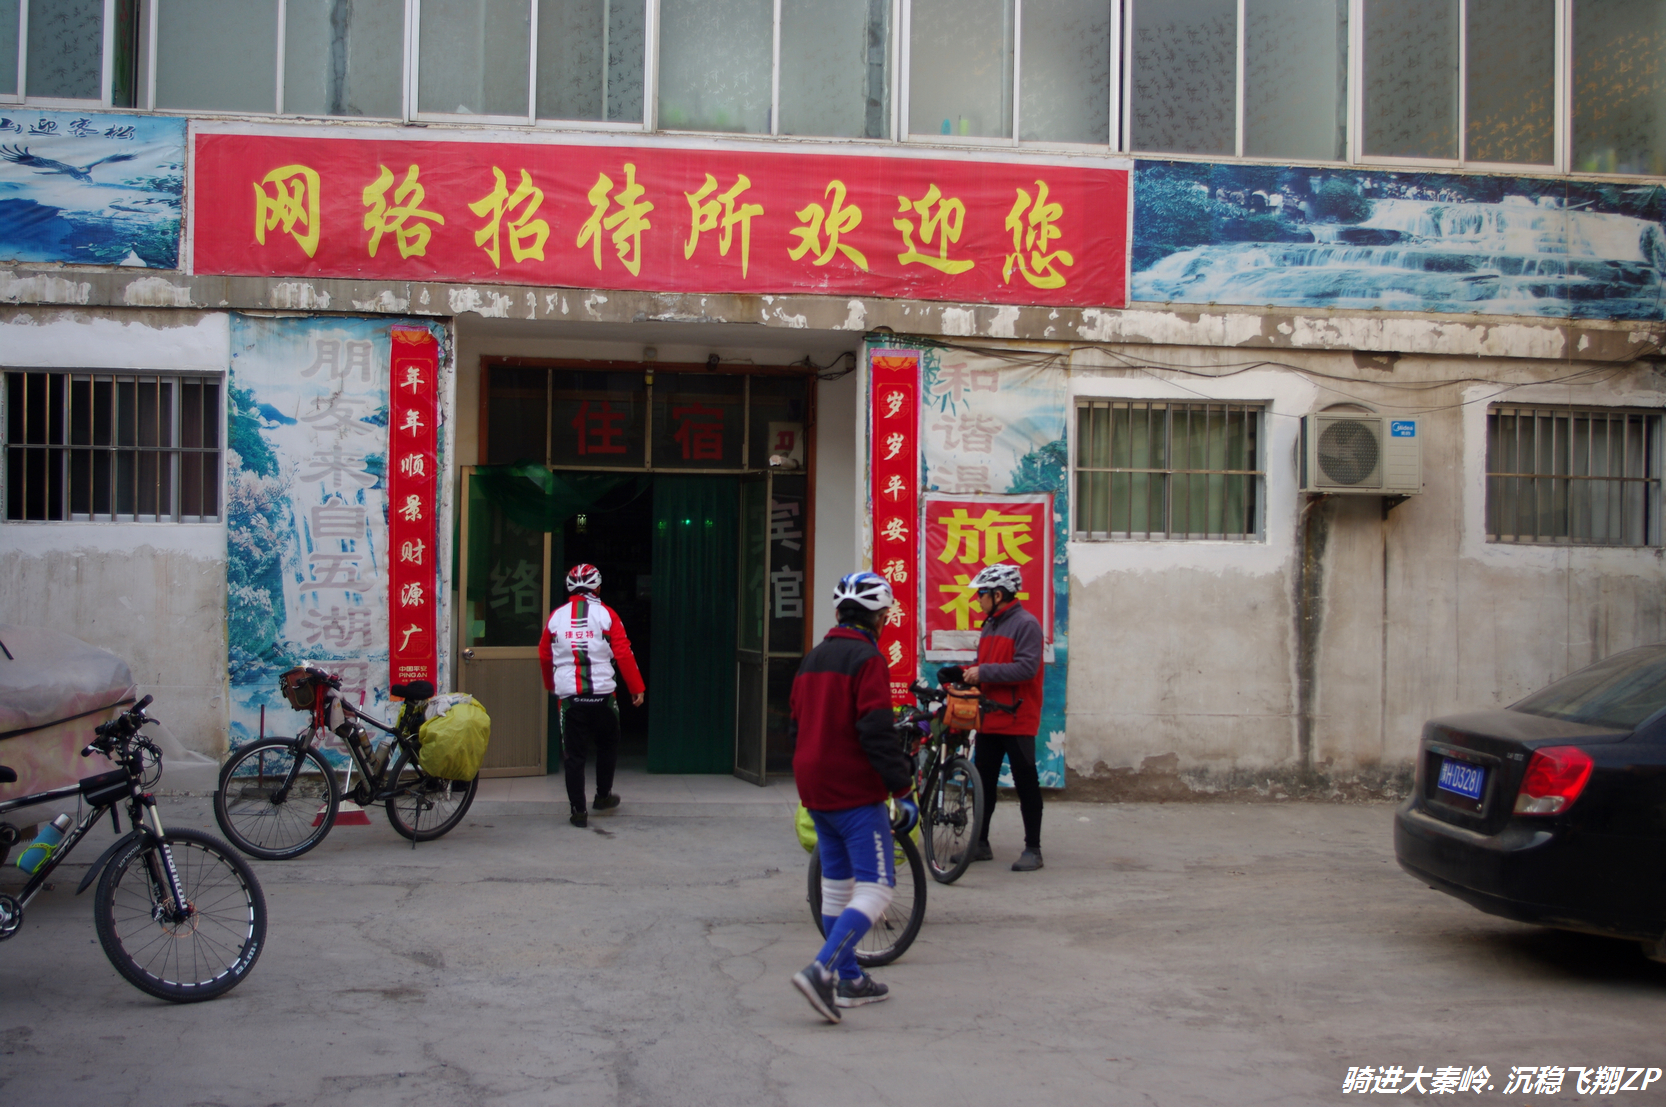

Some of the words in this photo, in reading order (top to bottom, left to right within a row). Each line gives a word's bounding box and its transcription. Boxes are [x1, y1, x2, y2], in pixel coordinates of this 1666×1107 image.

[253, 162, 1074, 290] 网络招待所欢迎您
[571, 400, 724, 461] 住宿
[300, 338, 379, 753] 朋友来自五湖四
[398, 366, 426, 652] 年年顺景财源广
[881, 391, 909, 668] 岁岁平安福寿多
[565, 631, 594, 640] 捷安特
[163, 842, 188, 910] manitou
